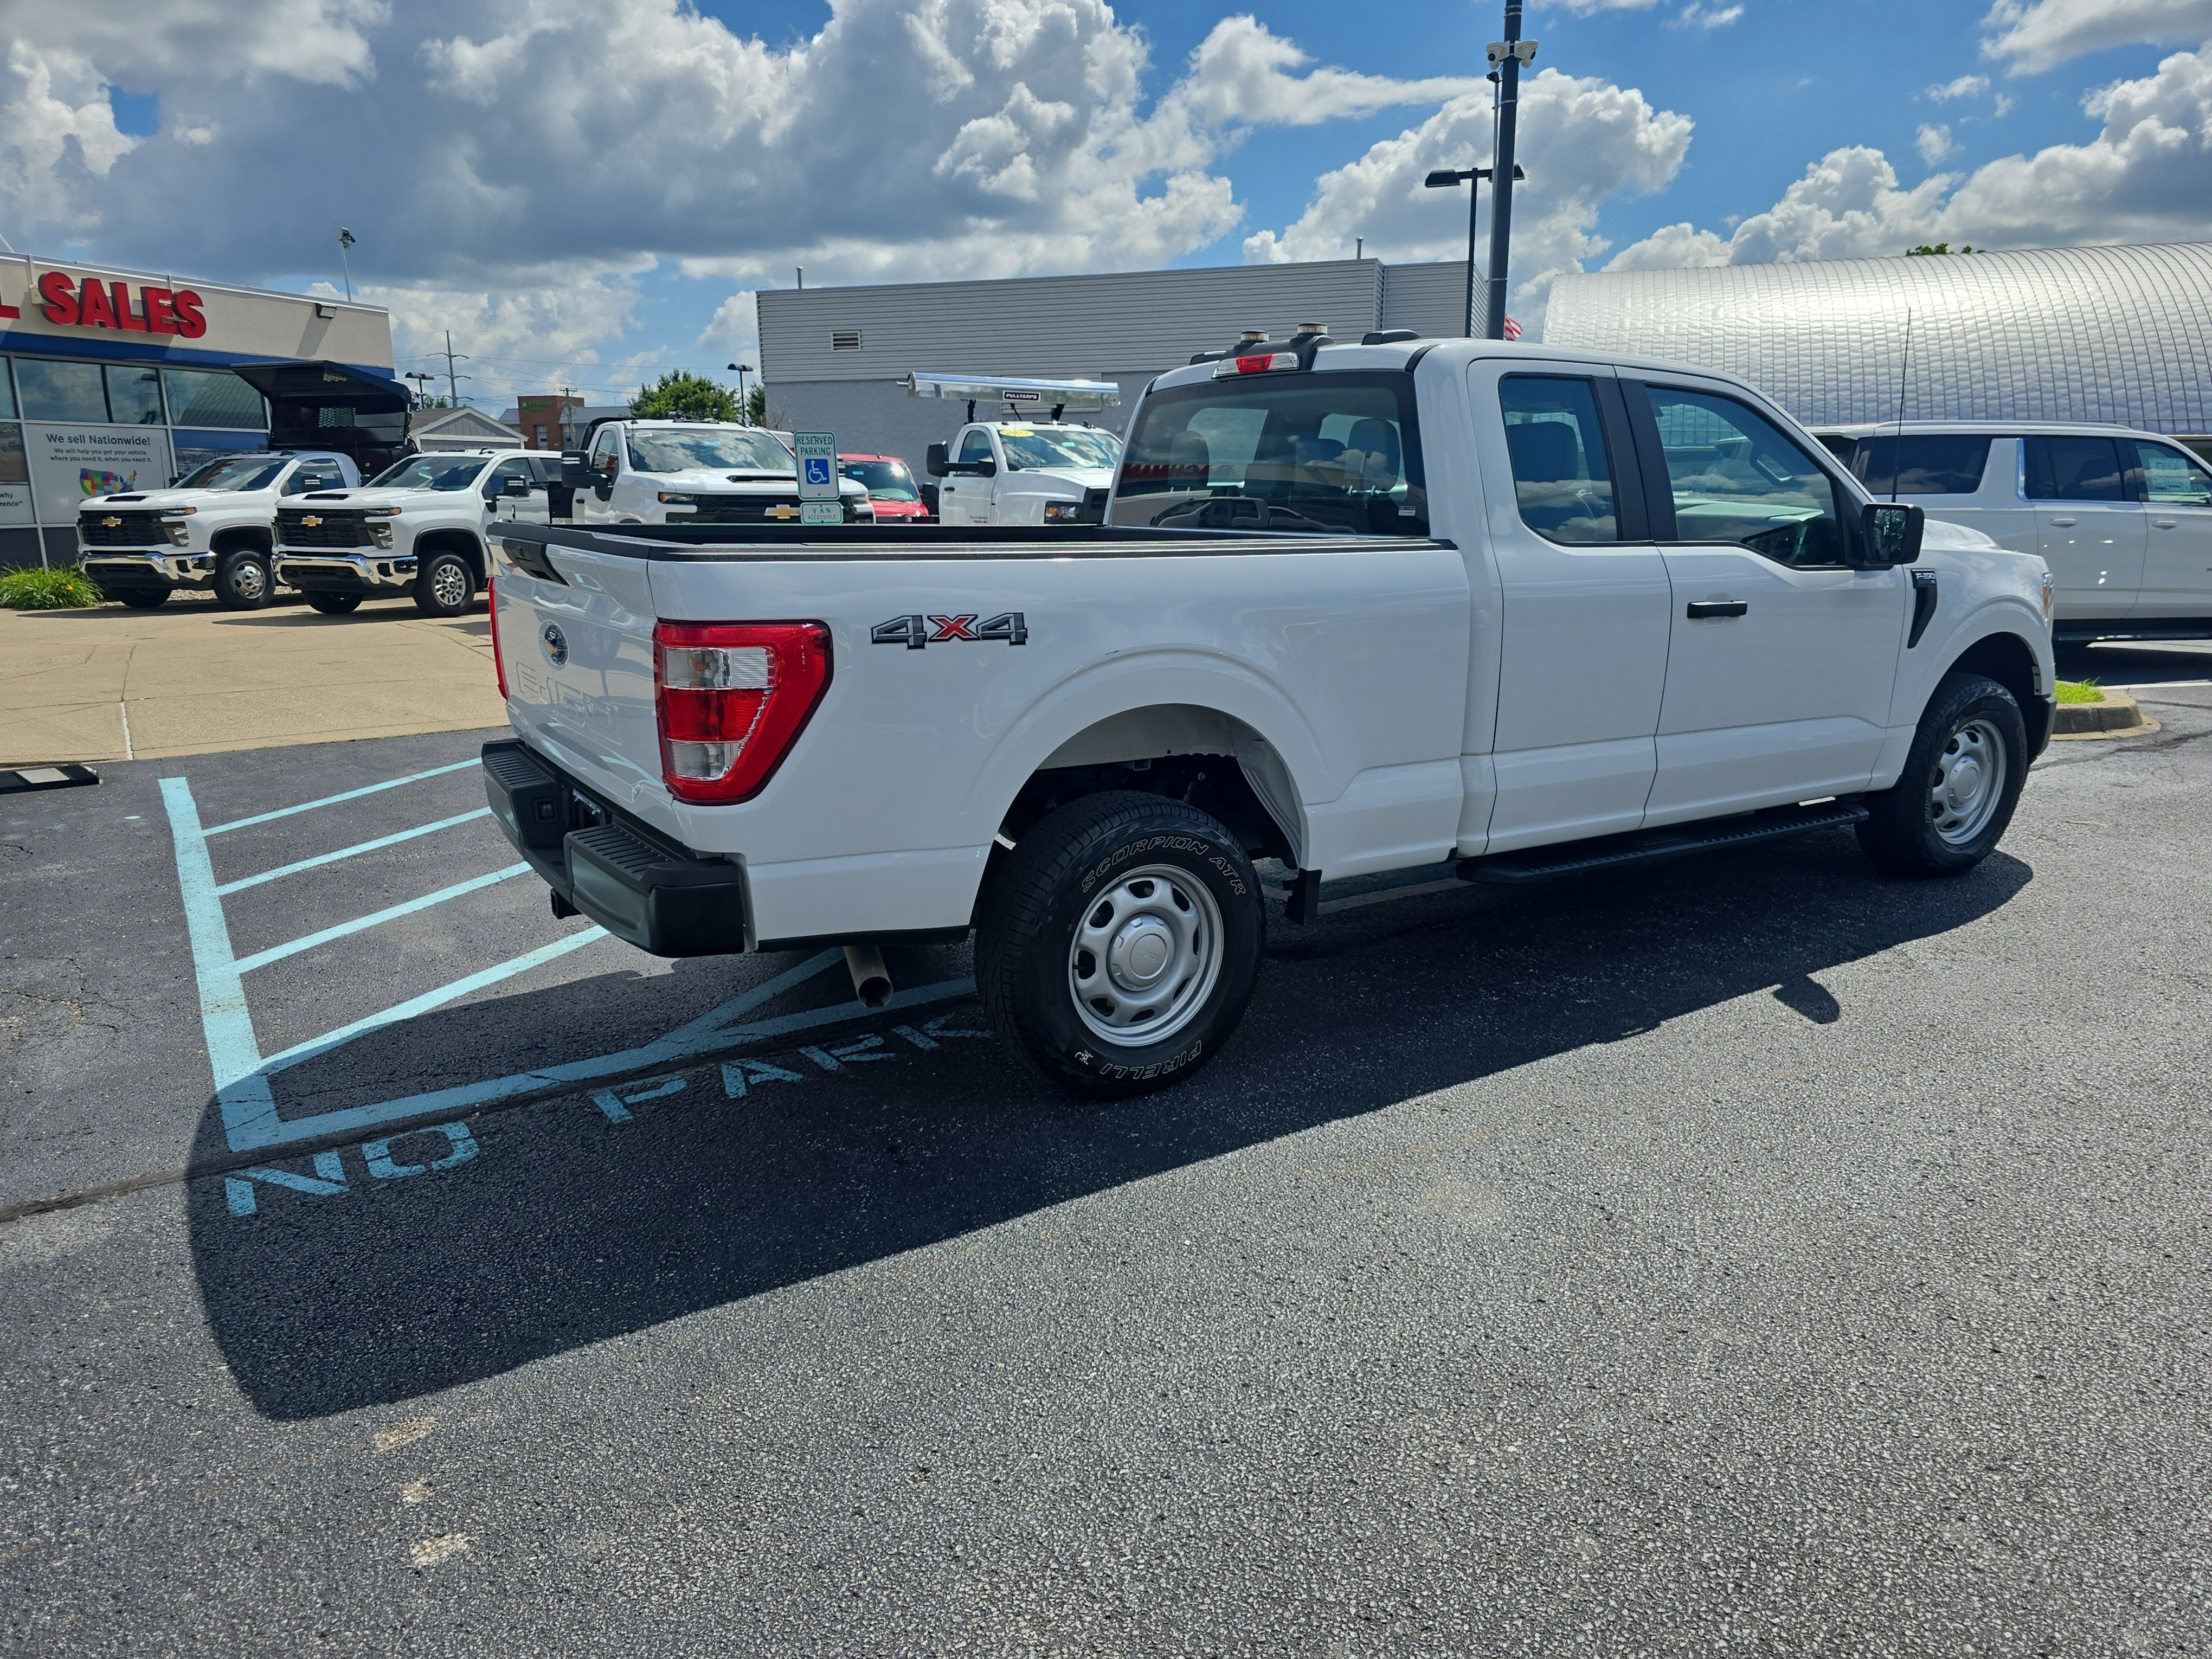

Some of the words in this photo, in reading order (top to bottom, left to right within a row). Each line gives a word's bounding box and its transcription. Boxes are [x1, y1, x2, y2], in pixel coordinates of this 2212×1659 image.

[38, 271, 207, 338] SALES
[46, 434, 64, 443] We
[68, 434, 86, 443] sell
[89, 435, 151, 446] Nationwide!
[796, 435, 833, 445] RESERVED
[800, 447, 831, 456] PARKING
[1081, 836, 1209, 893] SCORPION
[1210, 856, 1246, 896] ATR
[1099, 1040, 1202, 1079] PIRELLI
[225, 1120, 480, 1218] NO
